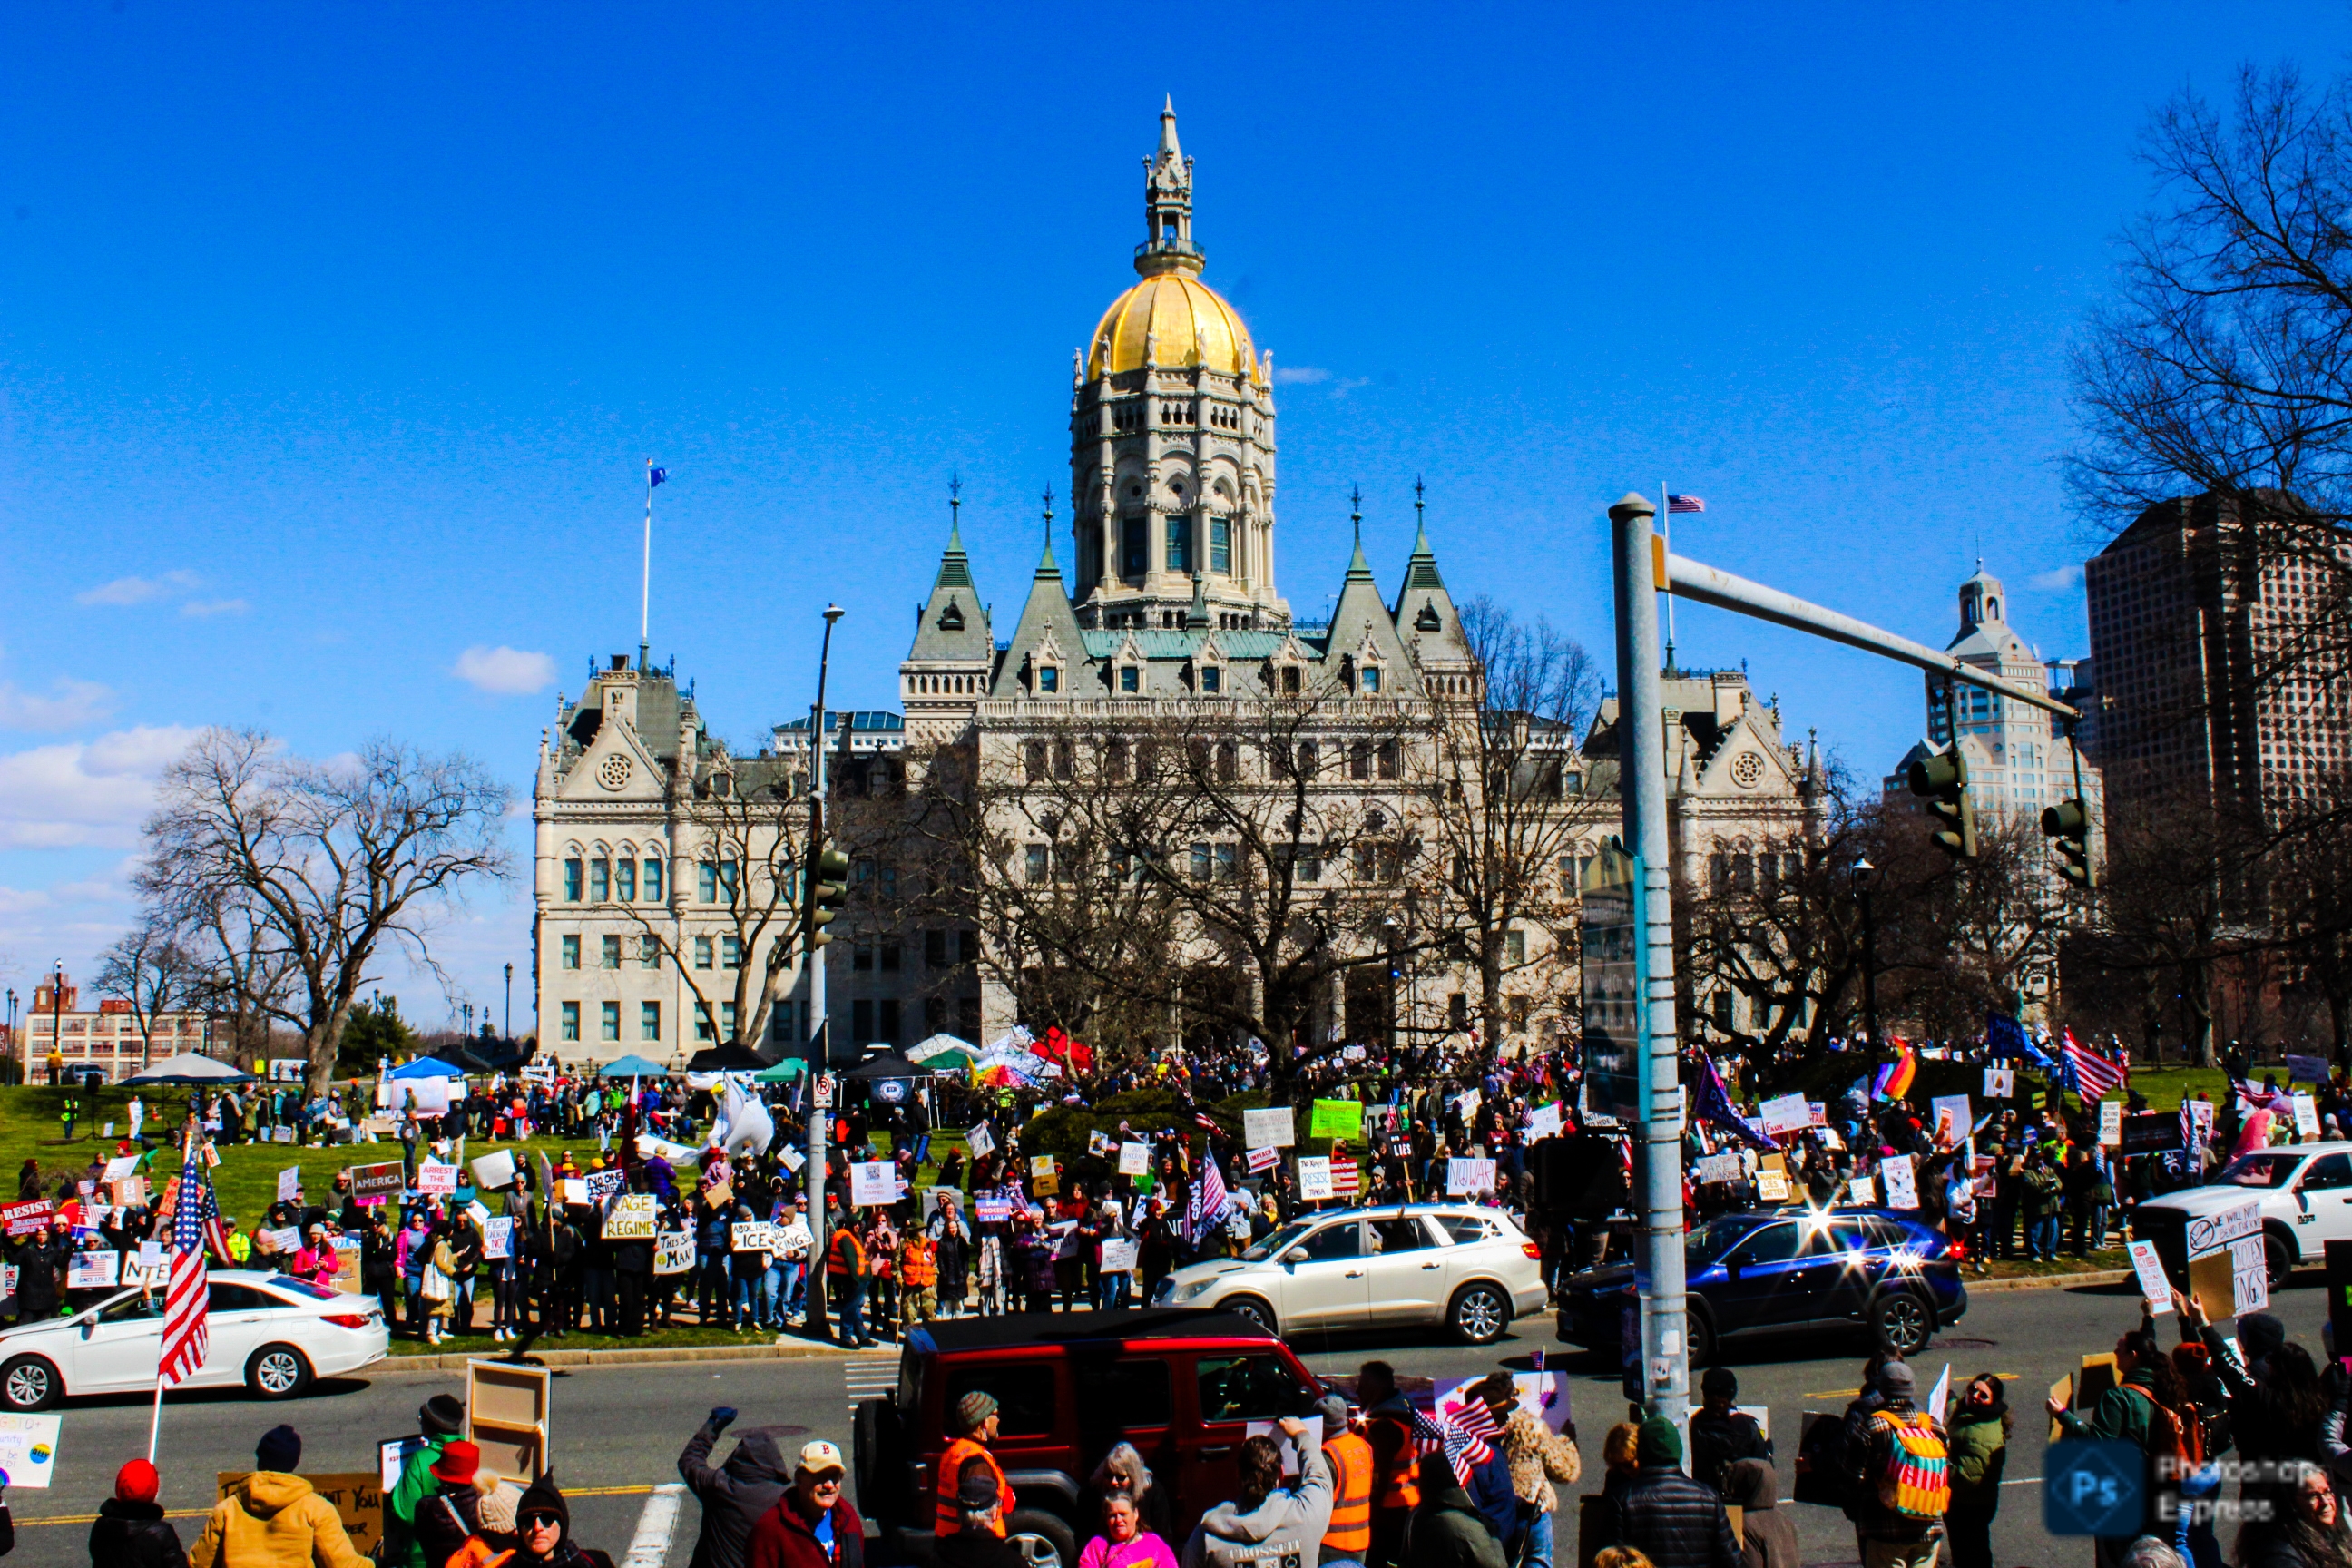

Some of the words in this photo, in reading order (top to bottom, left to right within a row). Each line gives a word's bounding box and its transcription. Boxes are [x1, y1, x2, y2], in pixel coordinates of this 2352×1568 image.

[1394, 1143, 1412, 1157] LIES
[423, 1166, 454, 1174] ARREST
[1469, 1161, 1494, 1186] WAR
[1757, 1171, 1784, 1181] ORANGE
[356, 1174, 402, 1189] AMERICA
[418, 1184, 456, 1192] PRESIDENT
[587, 1175, 603, 1188] NO
[1761, 1188, 1785, 1196] MATTER
[3, 1200, 53, 1220] RESIST
[609, 1195, 652, 1212] RAGE
[638, 1212, 652, 1220] THE
[2212, 1216, 2223, 1228] WE
[2226, 1211, 2242, 1224] WILL
[2244, 1203, 2259, 1219] NOT
[486, 1219, 511, 1229] FIGHT
[607, 1220, 653, 1237] REGIME
[733, 1223, 769, 1233] ABOLISH
[491, 1238, 506, 1249] NOT
[743, 1233, 767, 1248] ICE
[776, 1232, 812, 1252] KINGS
[2234, 1268, 2266, 1309] INGS
[820, 1444, 830, 1455] B
[1229, 1538, 1302, 1560] CROSSFIT
